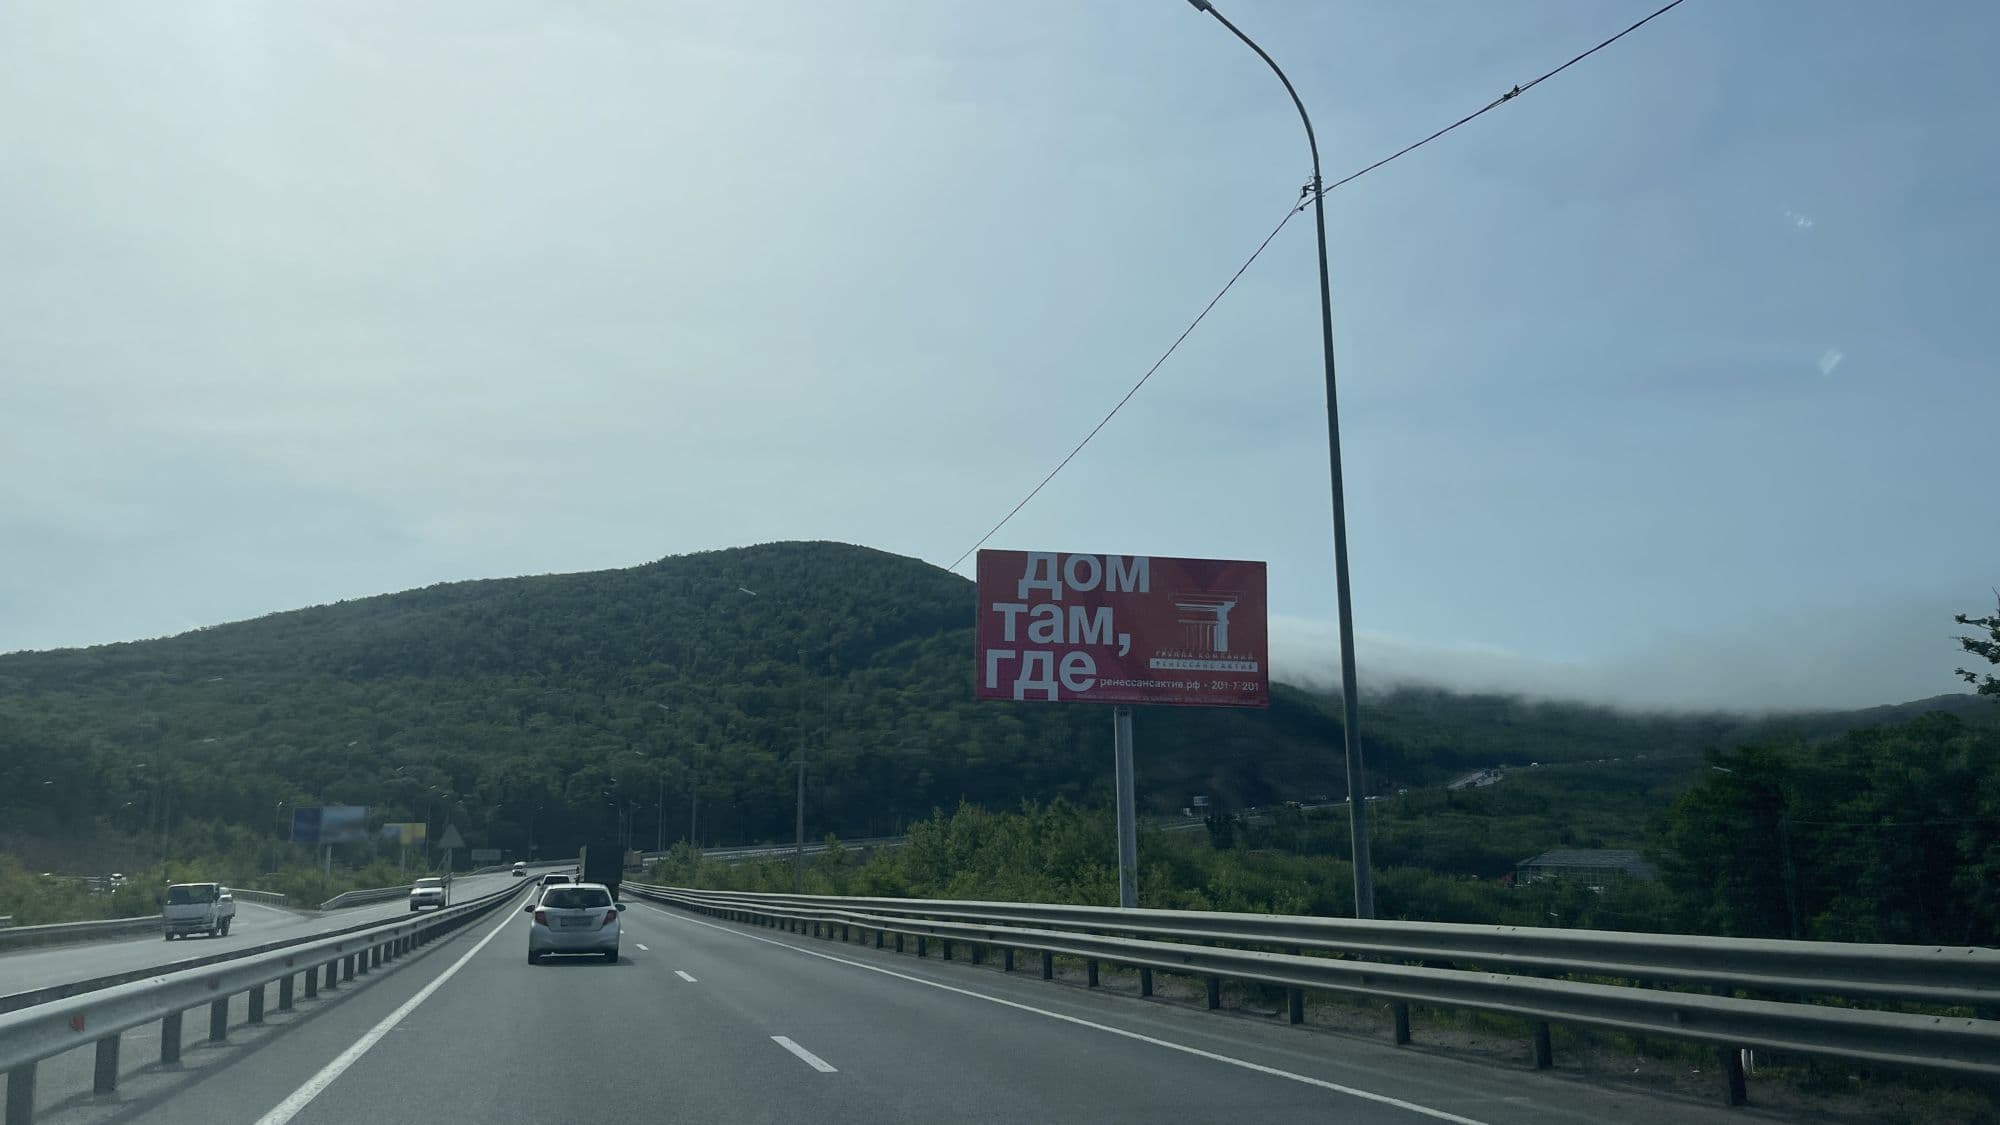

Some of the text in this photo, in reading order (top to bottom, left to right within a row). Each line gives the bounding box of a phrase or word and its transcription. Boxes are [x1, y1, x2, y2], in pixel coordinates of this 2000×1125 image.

[1018, 551, 1150, 600] дом
[992, 602, 1131, 657] там,
[986, 649, 1097, 701] где
[1100, 677, 1259, 692] ренессансактив.рф 201-7-201
